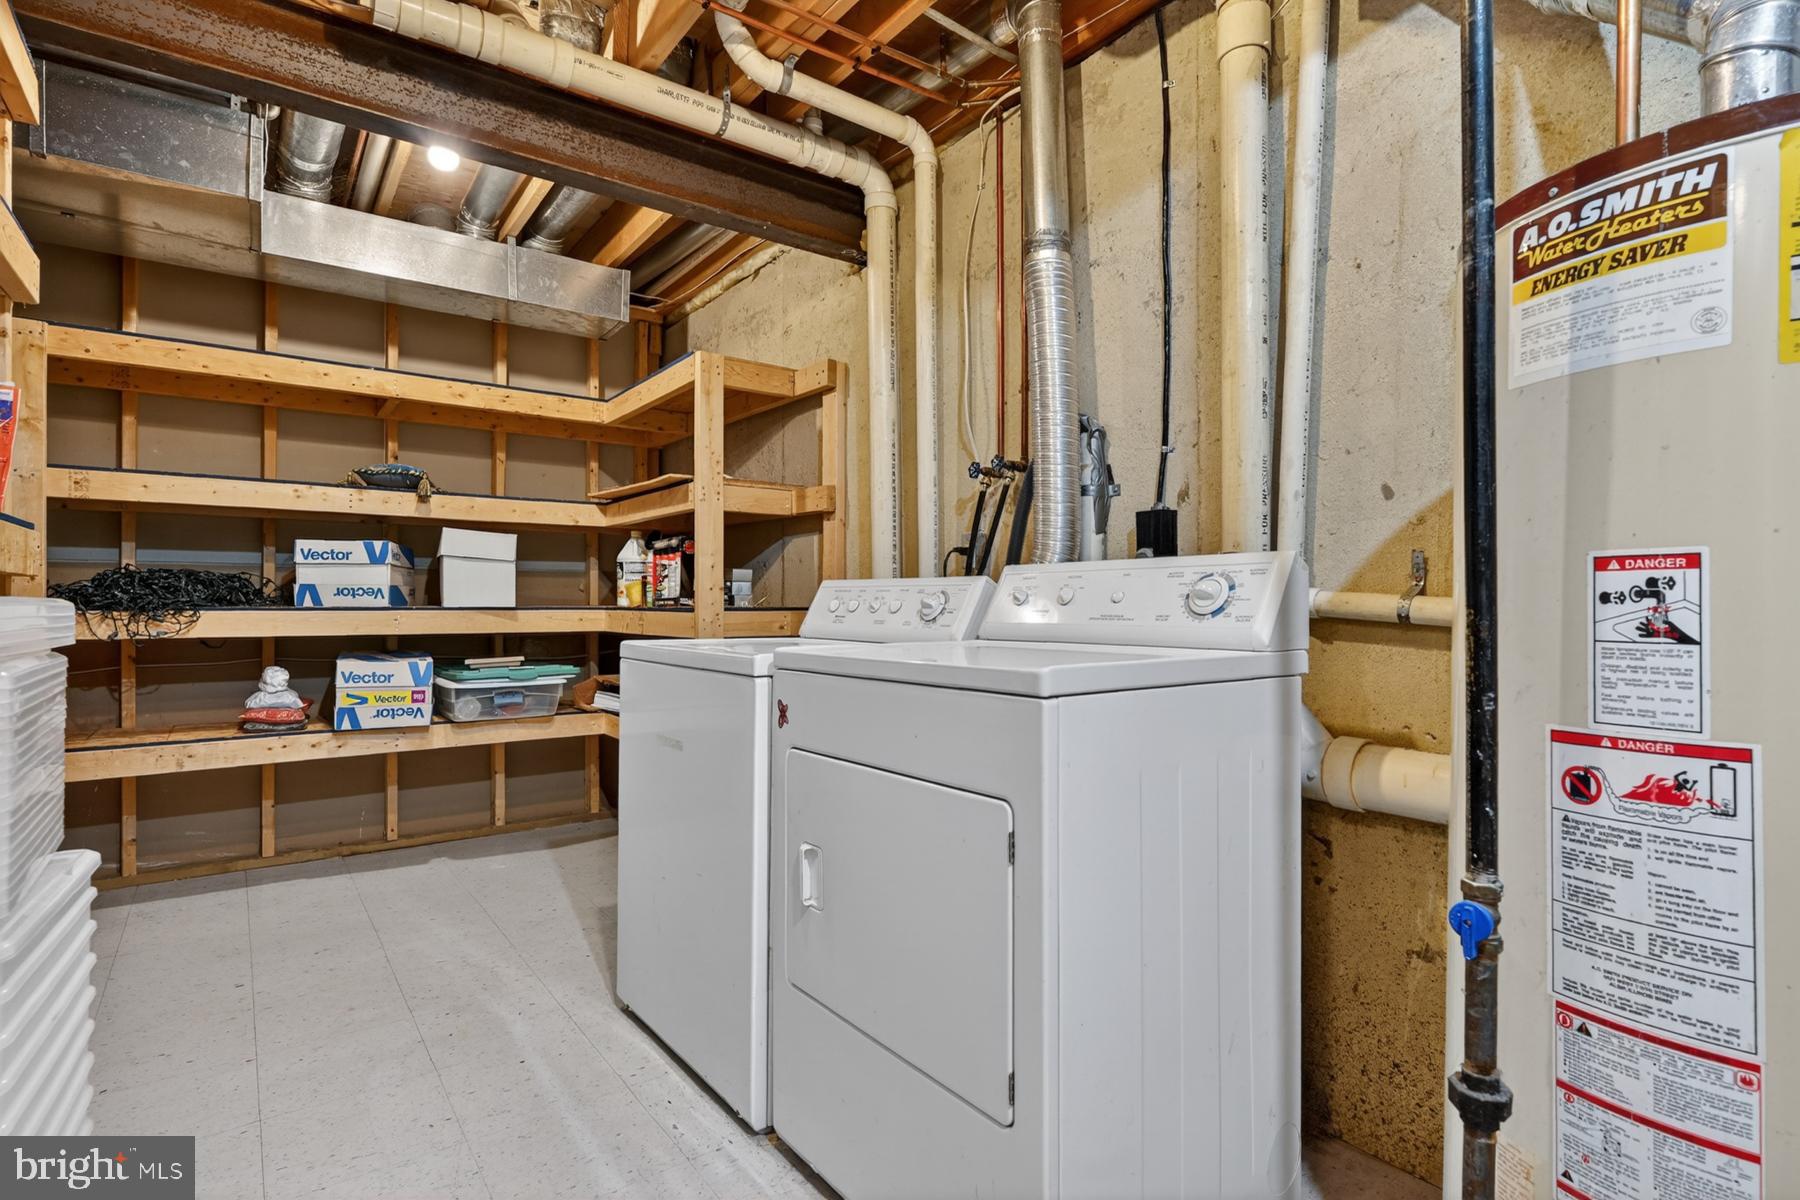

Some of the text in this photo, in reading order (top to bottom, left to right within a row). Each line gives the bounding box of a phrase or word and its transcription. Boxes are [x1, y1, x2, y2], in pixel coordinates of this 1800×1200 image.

[1518, 201, 1705, 269] Water Heaters
[1530, 233, 1689, 298] ENERGY SAVER
[300, 548, 352, 560] Vector
[1624, 558, 1687, 569] DANGER
[333, 587, 385, 599] Vector
[341, 671, 394, 684] Vector
[374, 695, 407, 703] Vector
[373, 707, 425, 719] Vector
[1617, 739, 1675, 754] DANGER
